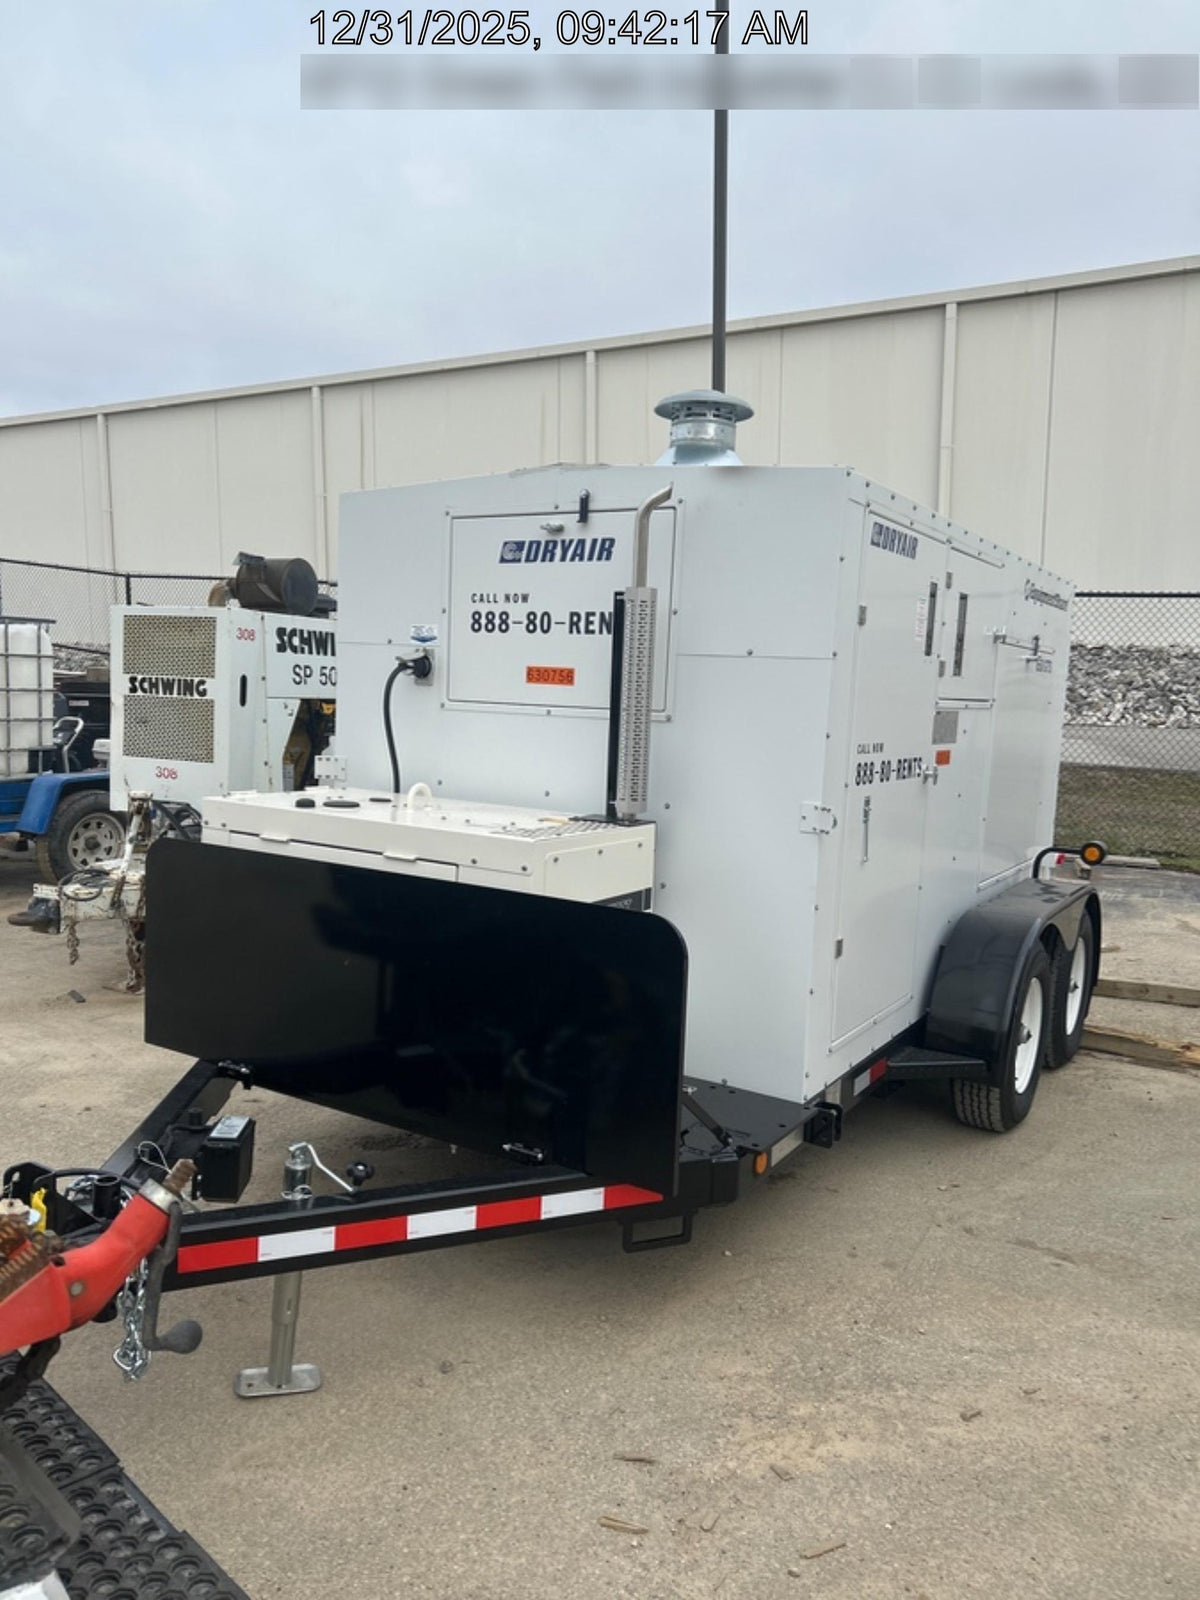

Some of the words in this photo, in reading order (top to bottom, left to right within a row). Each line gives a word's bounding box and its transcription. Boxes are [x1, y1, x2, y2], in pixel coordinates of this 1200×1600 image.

[524, 538, 616, 563] DRYAIR
[471, 593, 499, 604] CALL
[504, 593, 530, 603] NOW
[236, 628, 256, 641] 308
[293, 664, 312, 685] SP
[526, 667, 575, 685] 630756
[128, 675, 208, 698] SCHWING
[155, 766, 178, 780] 308
